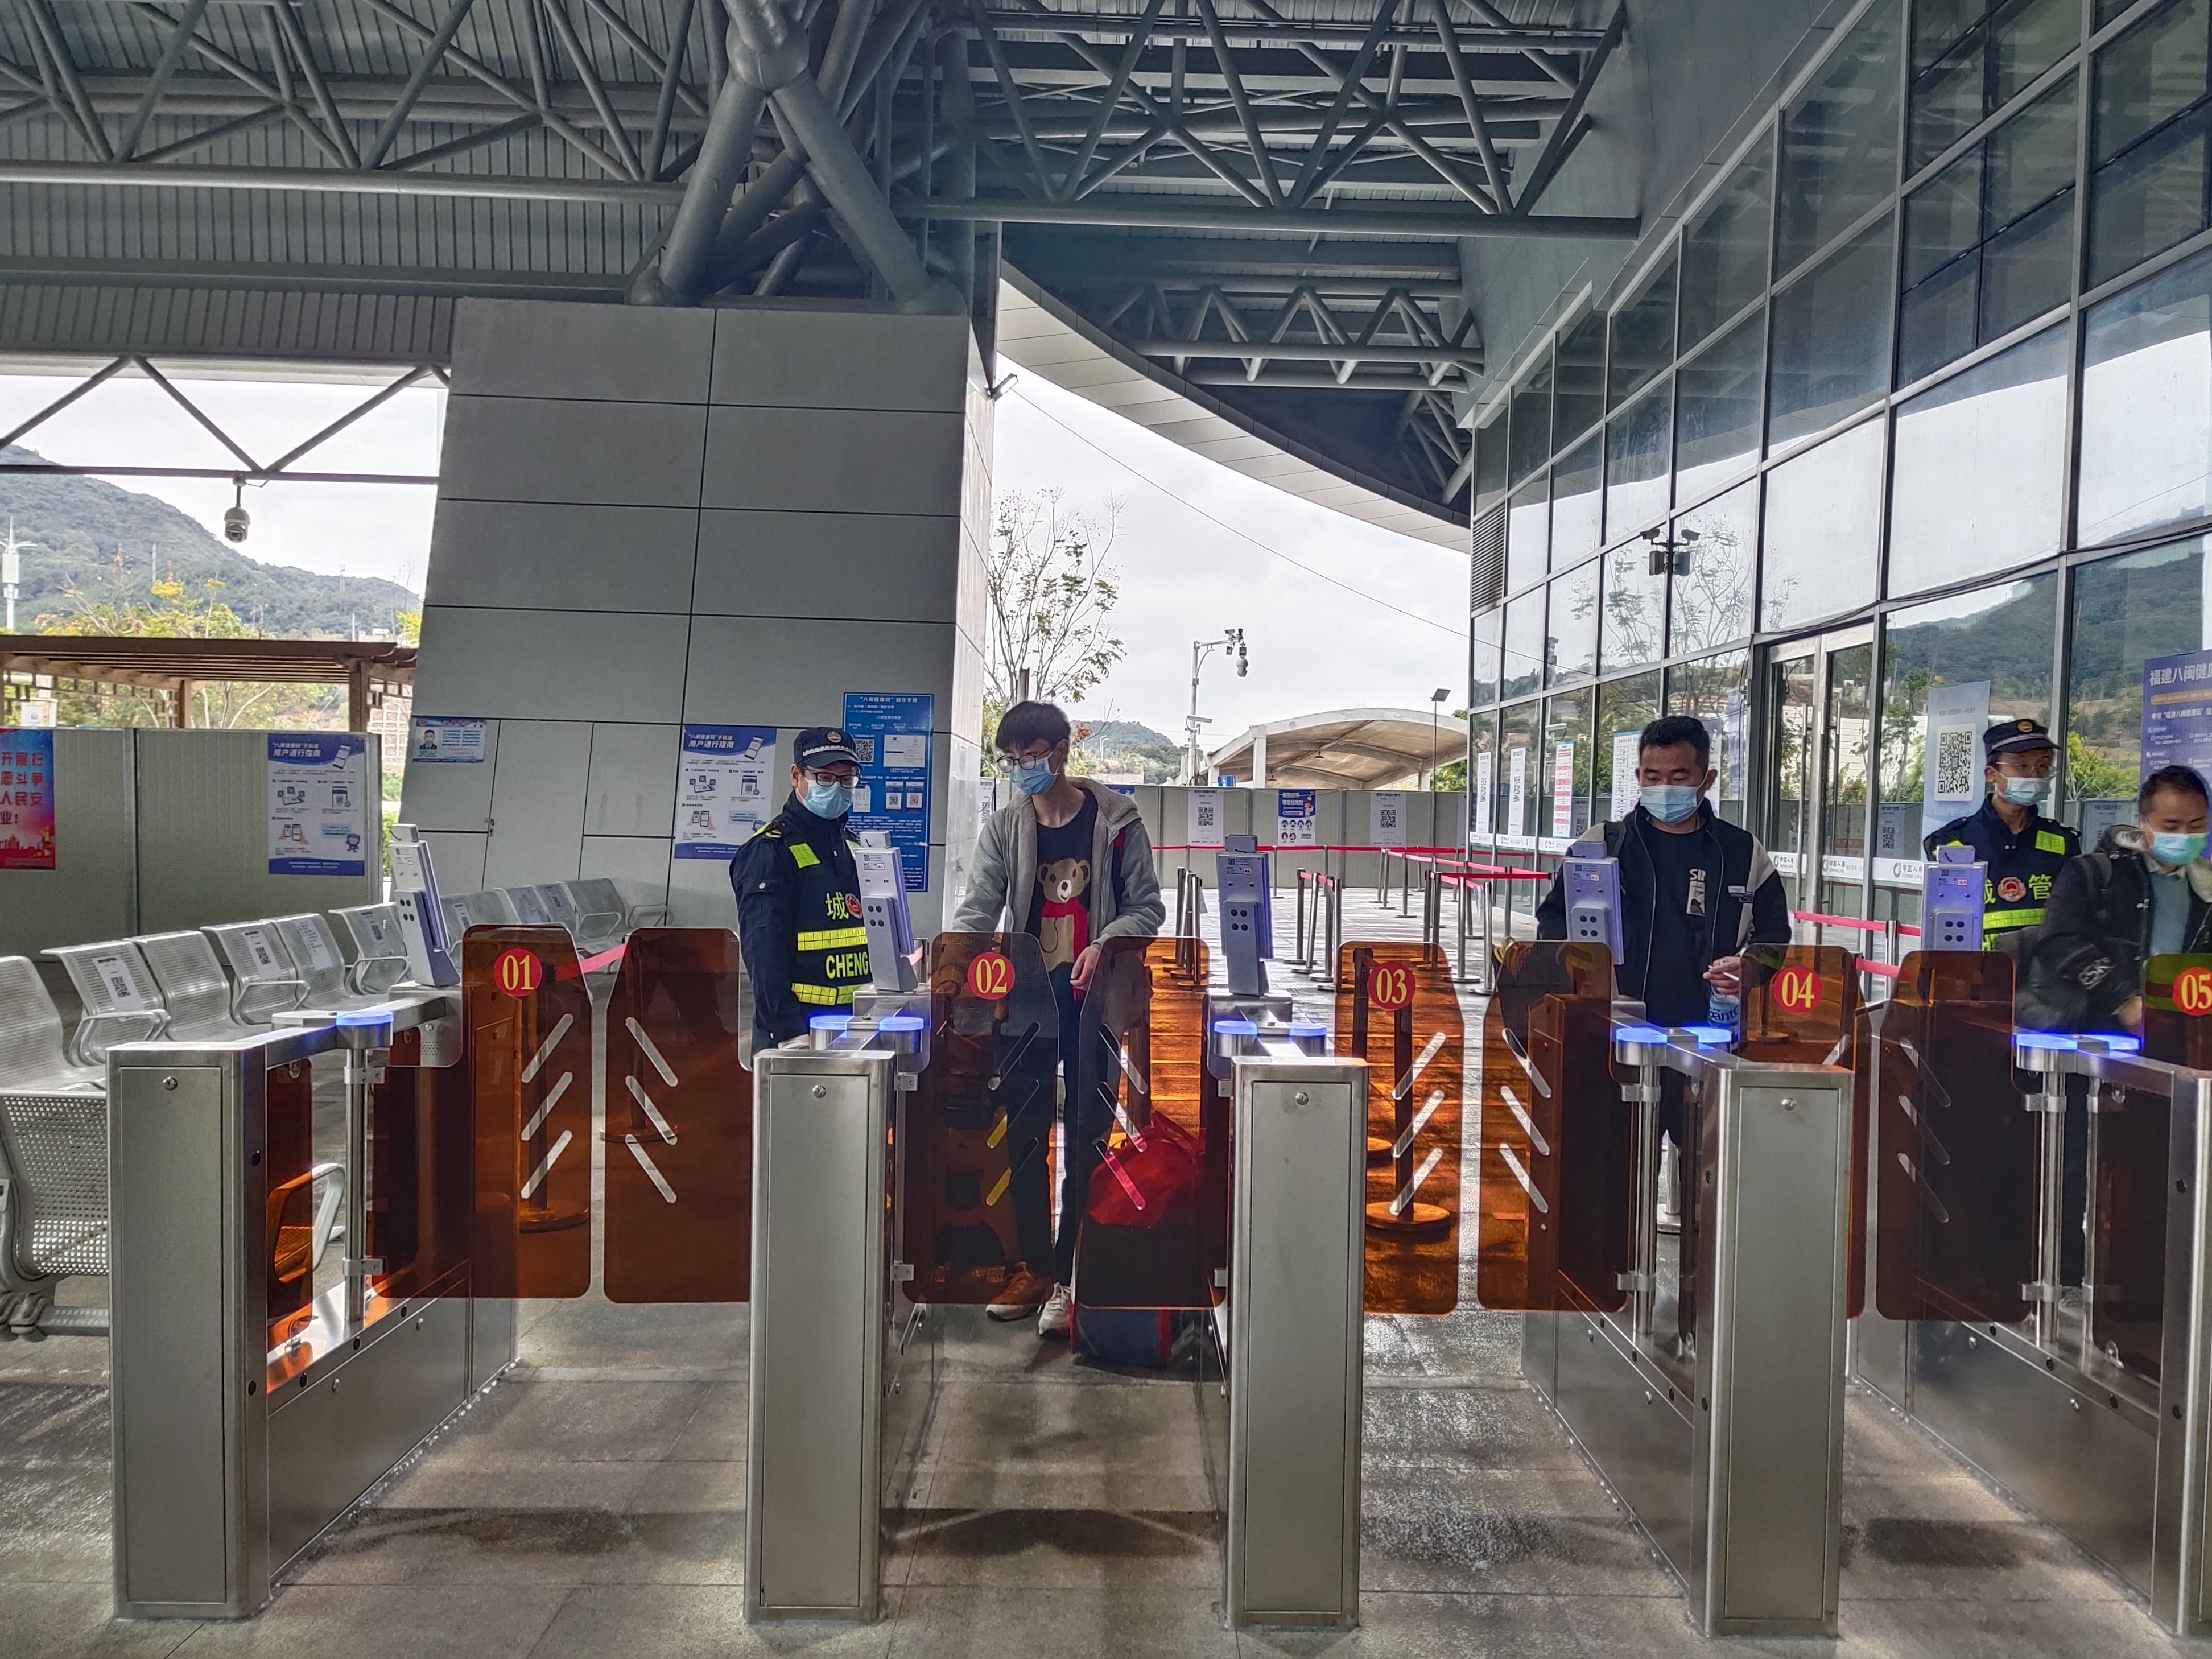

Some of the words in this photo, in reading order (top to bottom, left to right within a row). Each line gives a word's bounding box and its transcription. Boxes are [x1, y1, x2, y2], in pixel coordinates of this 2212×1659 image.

[688, 740, 735, 749] 用户通行指南
[0, 771, 43, 786] 恶斗争
[0, 790, 43, 806] 人民安
[2028, 874, 2052, 901] 管
[825, 892, 849, 921] 城
[502, 955, 534, 990] 01
[826, 951, 869, 980] CHENG
[976, 958, 1008, 993] 02
[1376, 968, 1407, 1004] 03
[1781, 972, 1814, 1008] 04
[2181, 974, 2212, 1009] 05
